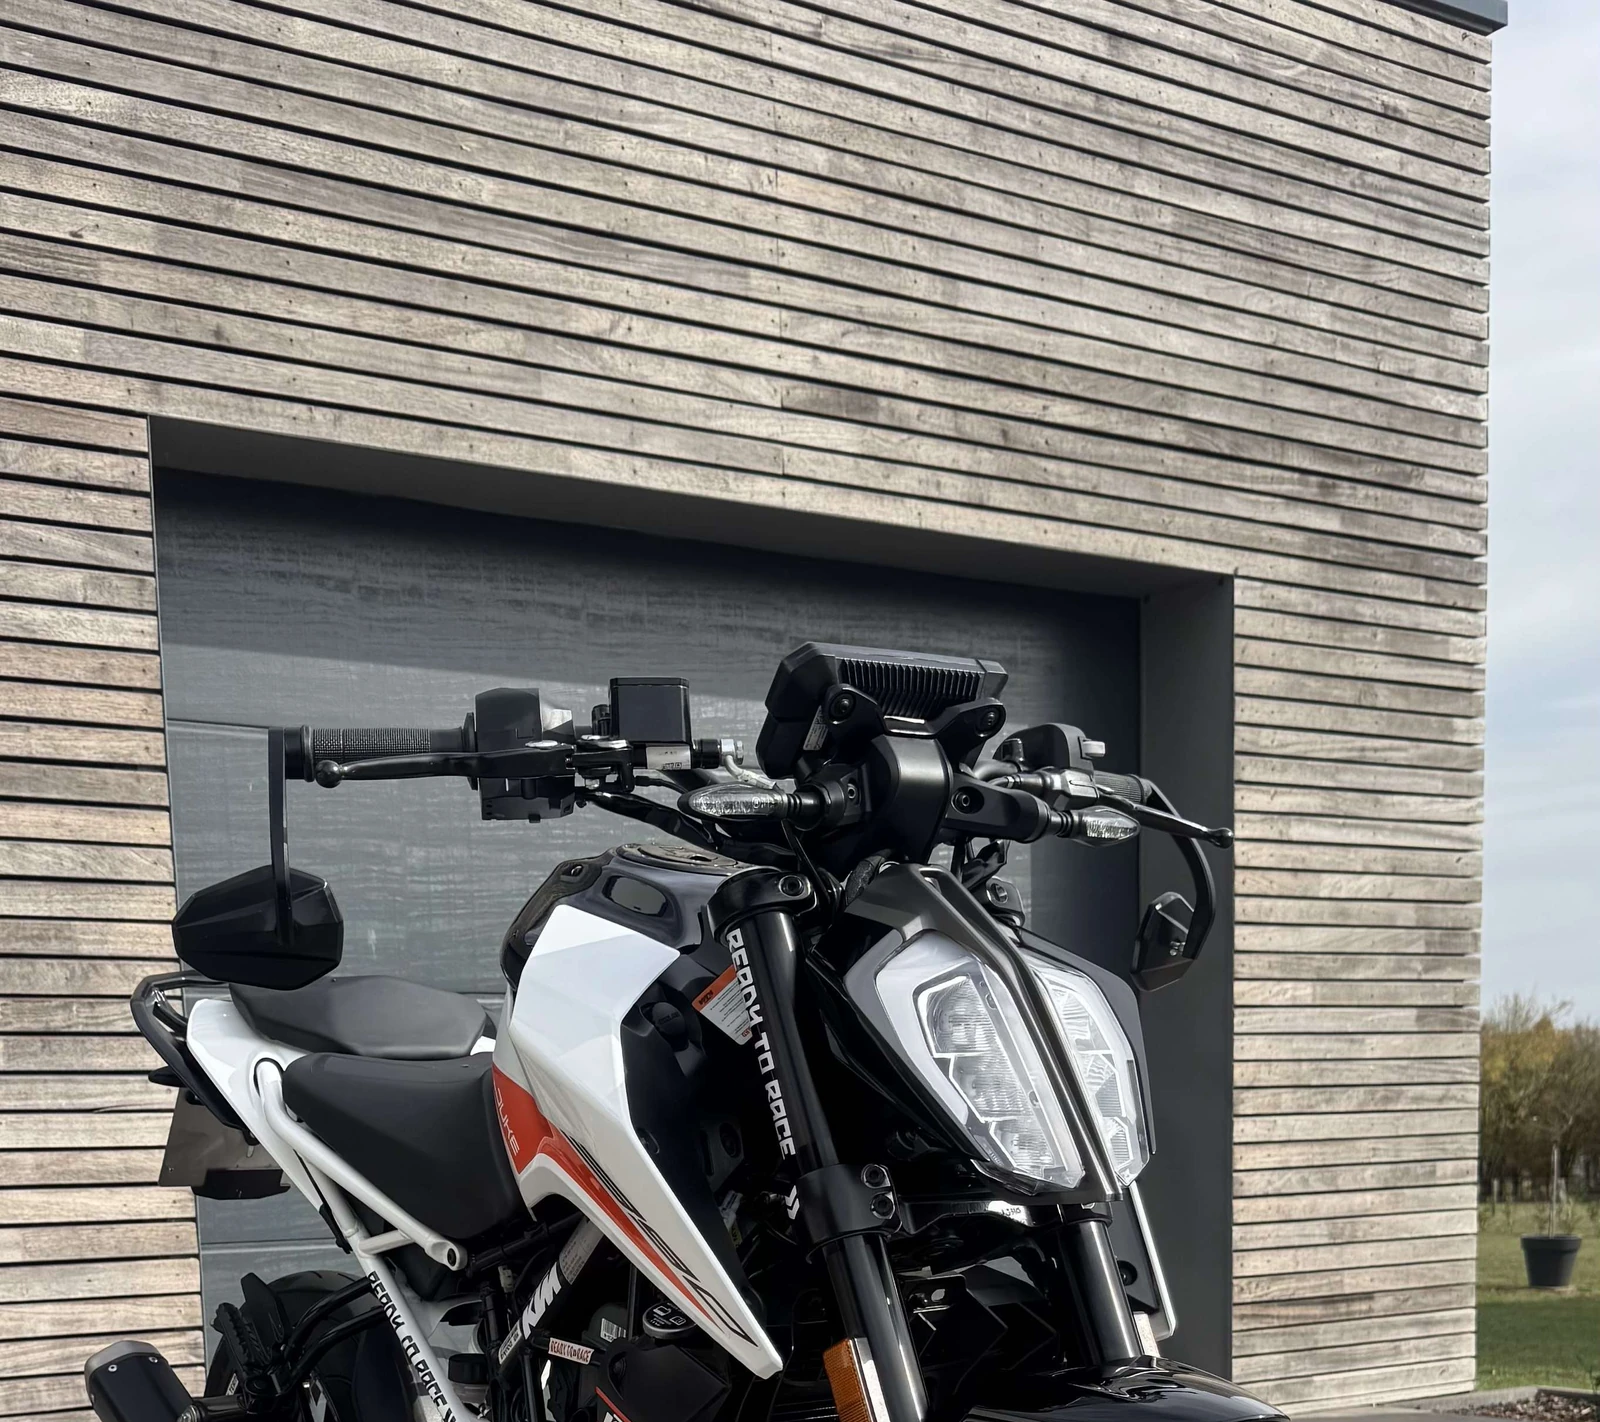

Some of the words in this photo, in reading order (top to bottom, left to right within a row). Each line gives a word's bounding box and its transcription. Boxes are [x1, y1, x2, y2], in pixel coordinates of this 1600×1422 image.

[725, 928, 763, 1028] READY
[754, 1032, 775, 1075] TO
[765, 1079, 796, 1160] RACE
[522, 1262, 562, 1340] KTM
[550, 1340, 566, 1355] READY
[576, 1347, 591, 1362] RACE
